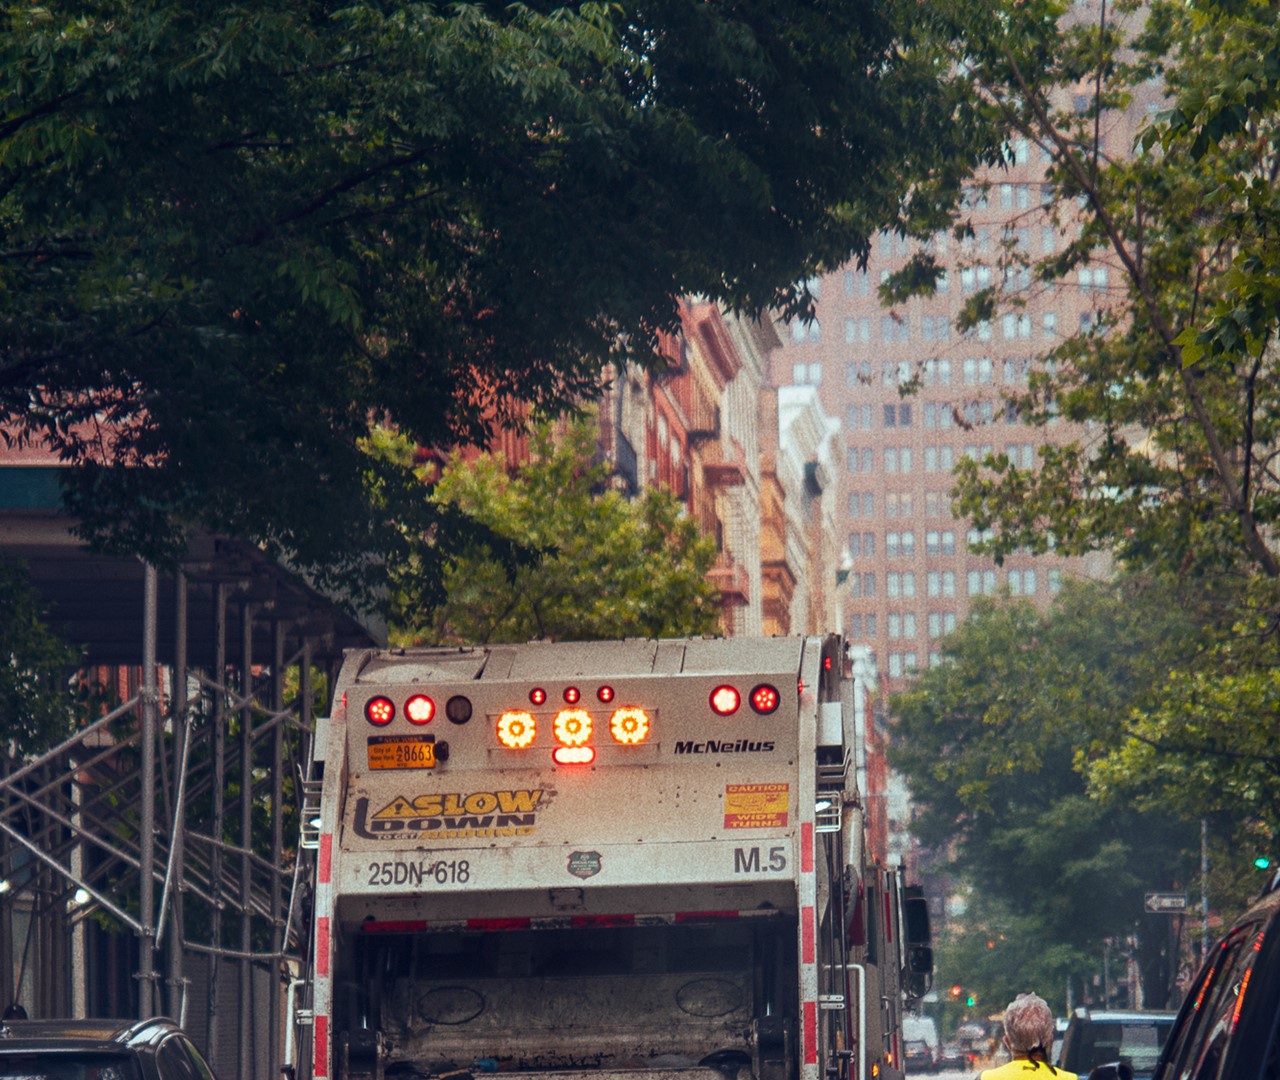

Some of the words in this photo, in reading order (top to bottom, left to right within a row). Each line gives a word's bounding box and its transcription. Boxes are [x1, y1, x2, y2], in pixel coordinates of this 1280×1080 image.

[674, 739, 776, 755] McNeilus
[728, 784, 787, 793] CAUTION
[413, 790, 543, 815] SLOW
[371, 814, 535, 831] DOWN
[730, 820, 782, 828] TURNS
[736, 813, 777, 821] WIDE
[734, 846, 787, 873] M.5
[368, 860, 470, 886] 25DN-618
